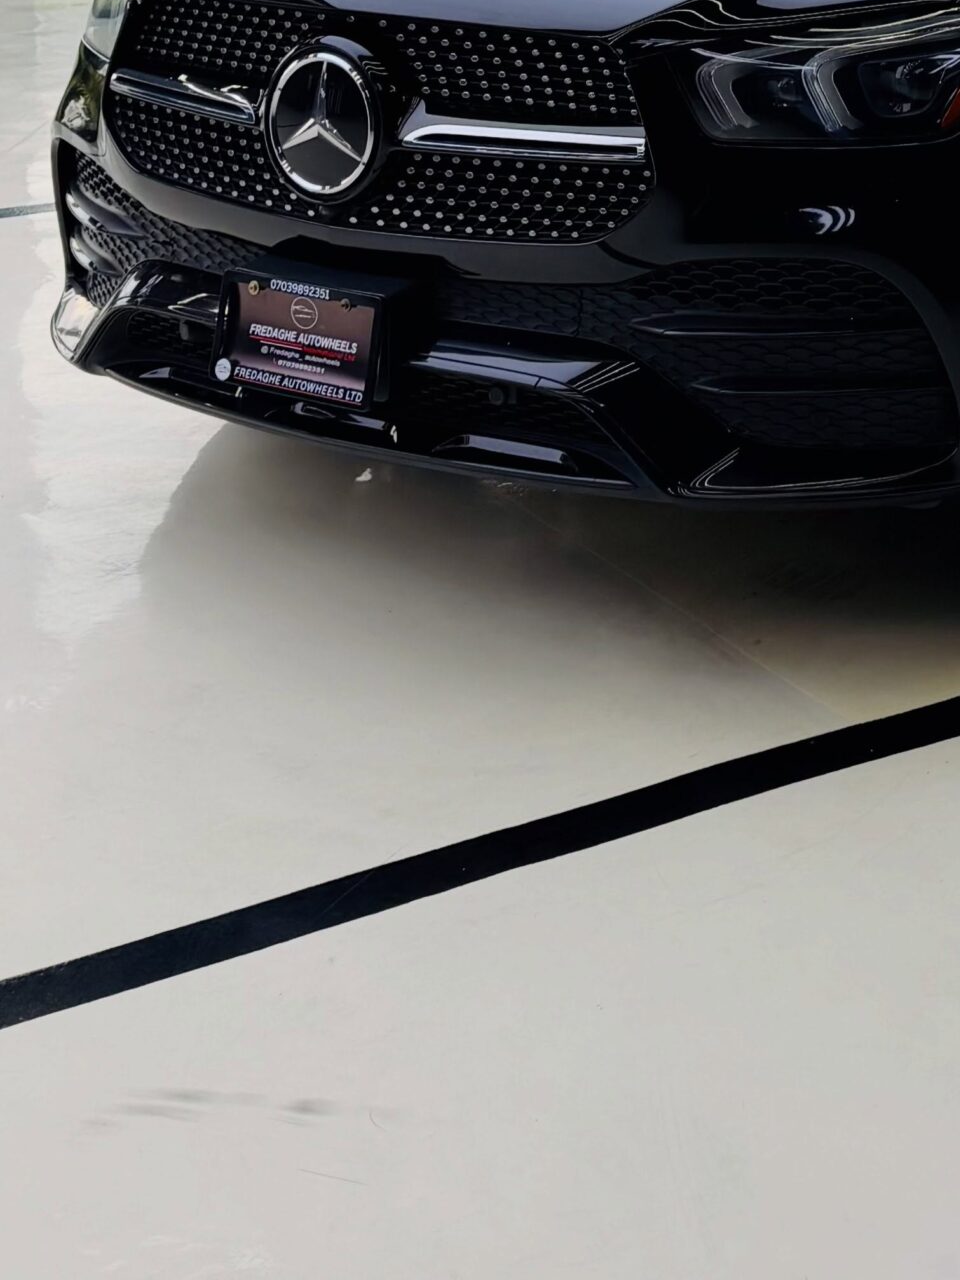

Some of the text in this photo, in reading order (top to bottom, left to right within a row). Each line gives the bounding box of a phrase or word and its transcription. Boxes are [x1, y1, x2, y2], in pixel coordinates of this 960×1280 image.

[270, 279, 330, 300] 07039892351
[250, 324, 297, 342] FREDAGHE
[298, 333, 358, 354] AUTOWHEELS
[234, 366, 363, 403] FREDAGHE AUTOWHEELS LTD
